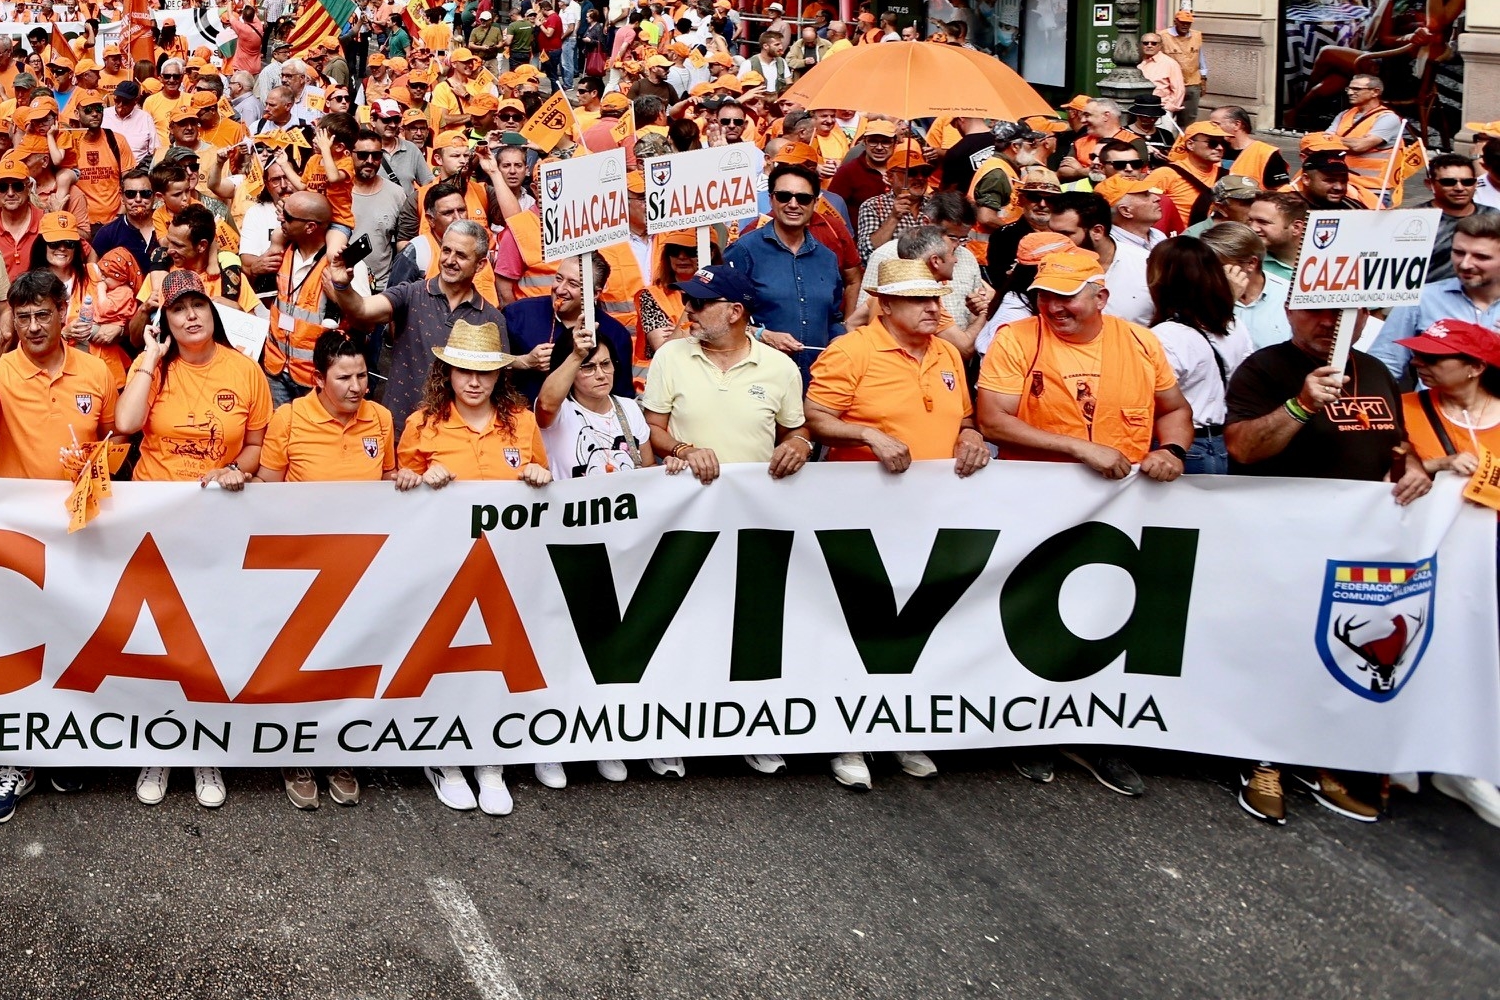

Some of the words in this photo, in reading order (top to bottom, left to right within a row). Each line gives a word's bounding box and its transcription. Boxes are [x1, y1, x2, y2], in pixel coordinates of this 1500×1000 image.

[538, 111, 547, 120] LA
[546, 97, 563, 111] CAZA
[678, 218, 685, 227] DE
[685, 216, 698, 225] CAZA
[698, 211, 727, 224] COMUNIDAD
[728, 207, 756, 218] VALENCIANA
[1327, 294, 1335, 303] DE
[1335, 293, 1350, 302] CAZA
[1351, 293, 1386, 301] COMUNIDAD
[1386, 292, 1419, 301] VALENCIANA
[1330, 401, 1383, 416] HART
[1481, 469, 1489, 479] LA
[471, 500, 550, 540] por
[564, 494, 639, 529] una
[1412, 570, 1433, 581] CAZA
[1394, 580, 1433, 597] VALENCIANA
[253, 722, 320, 755] DE
[338, 717, 474, 754] CAZA
[493, 696, 817, 747] COMUNIDAD
[836, 693, 1169, 735] VALENCIANA
